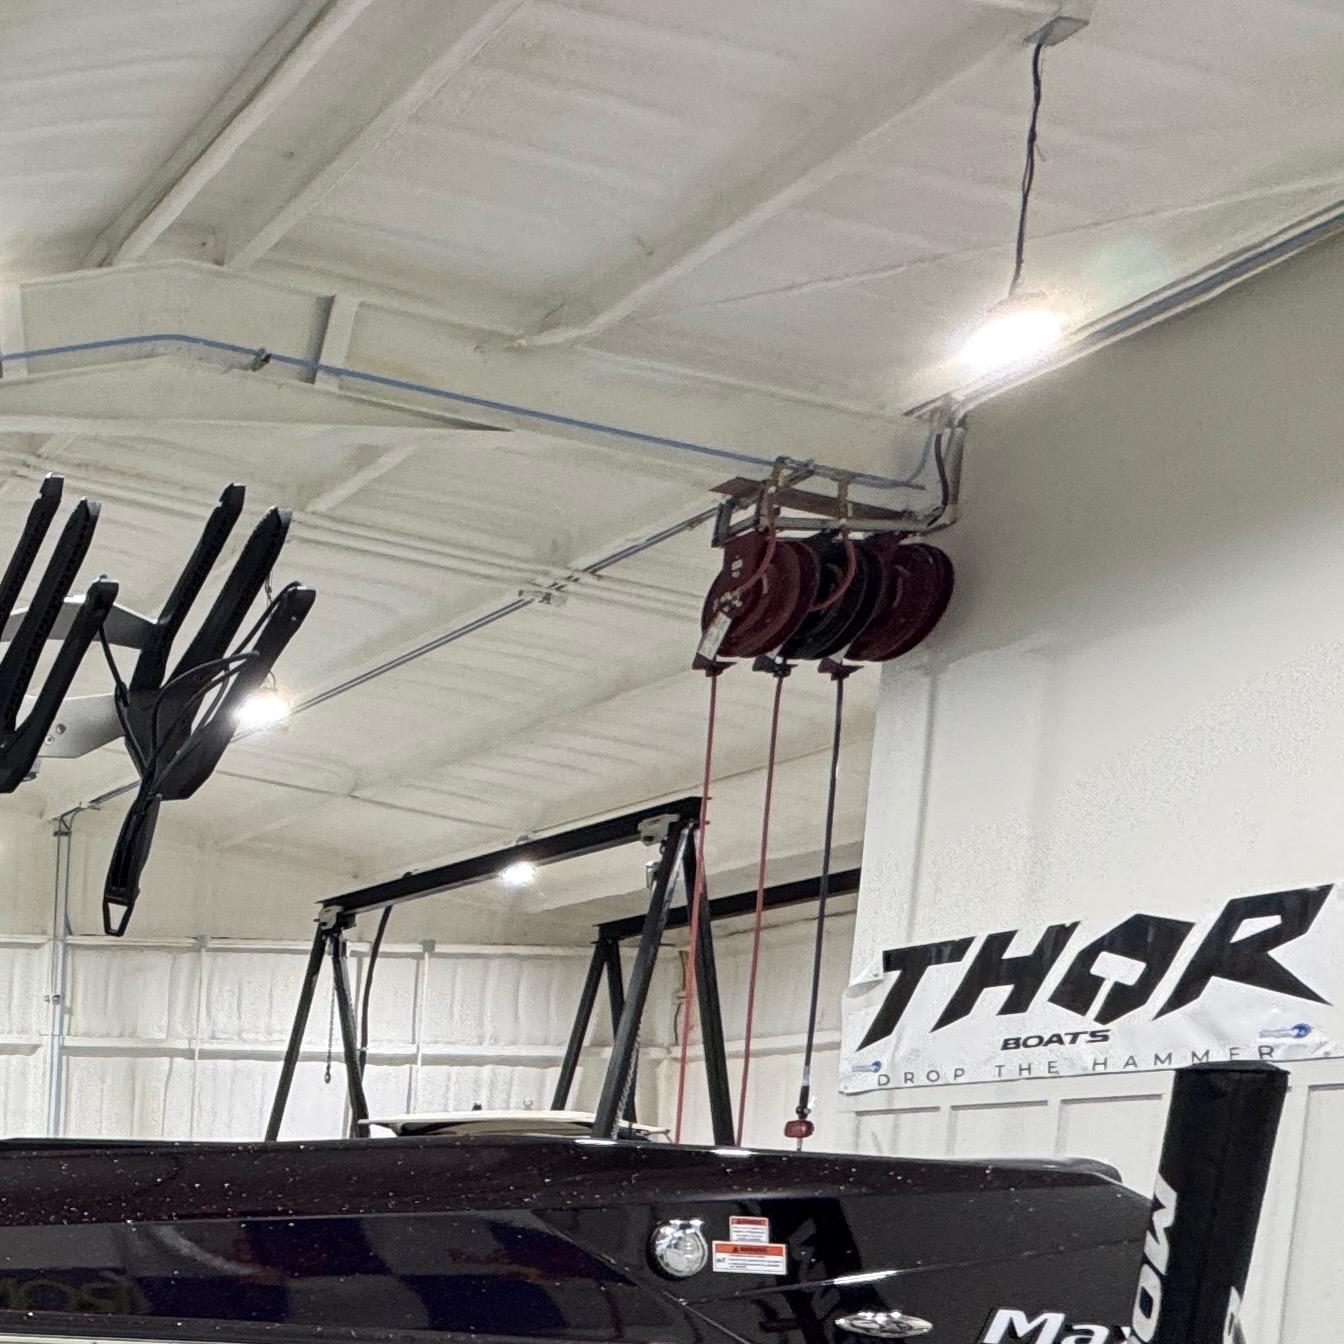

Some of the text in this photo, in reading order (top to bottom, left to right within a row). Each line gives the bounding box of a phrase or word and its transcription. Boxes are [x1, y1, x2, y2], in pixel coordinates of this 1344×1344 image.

[855, 883, 1334, 1053] THOR
[1000, 1029, 1111, 1051] BOATS
[877, 1044, 1276, 1087] DROP THE HAMMER
